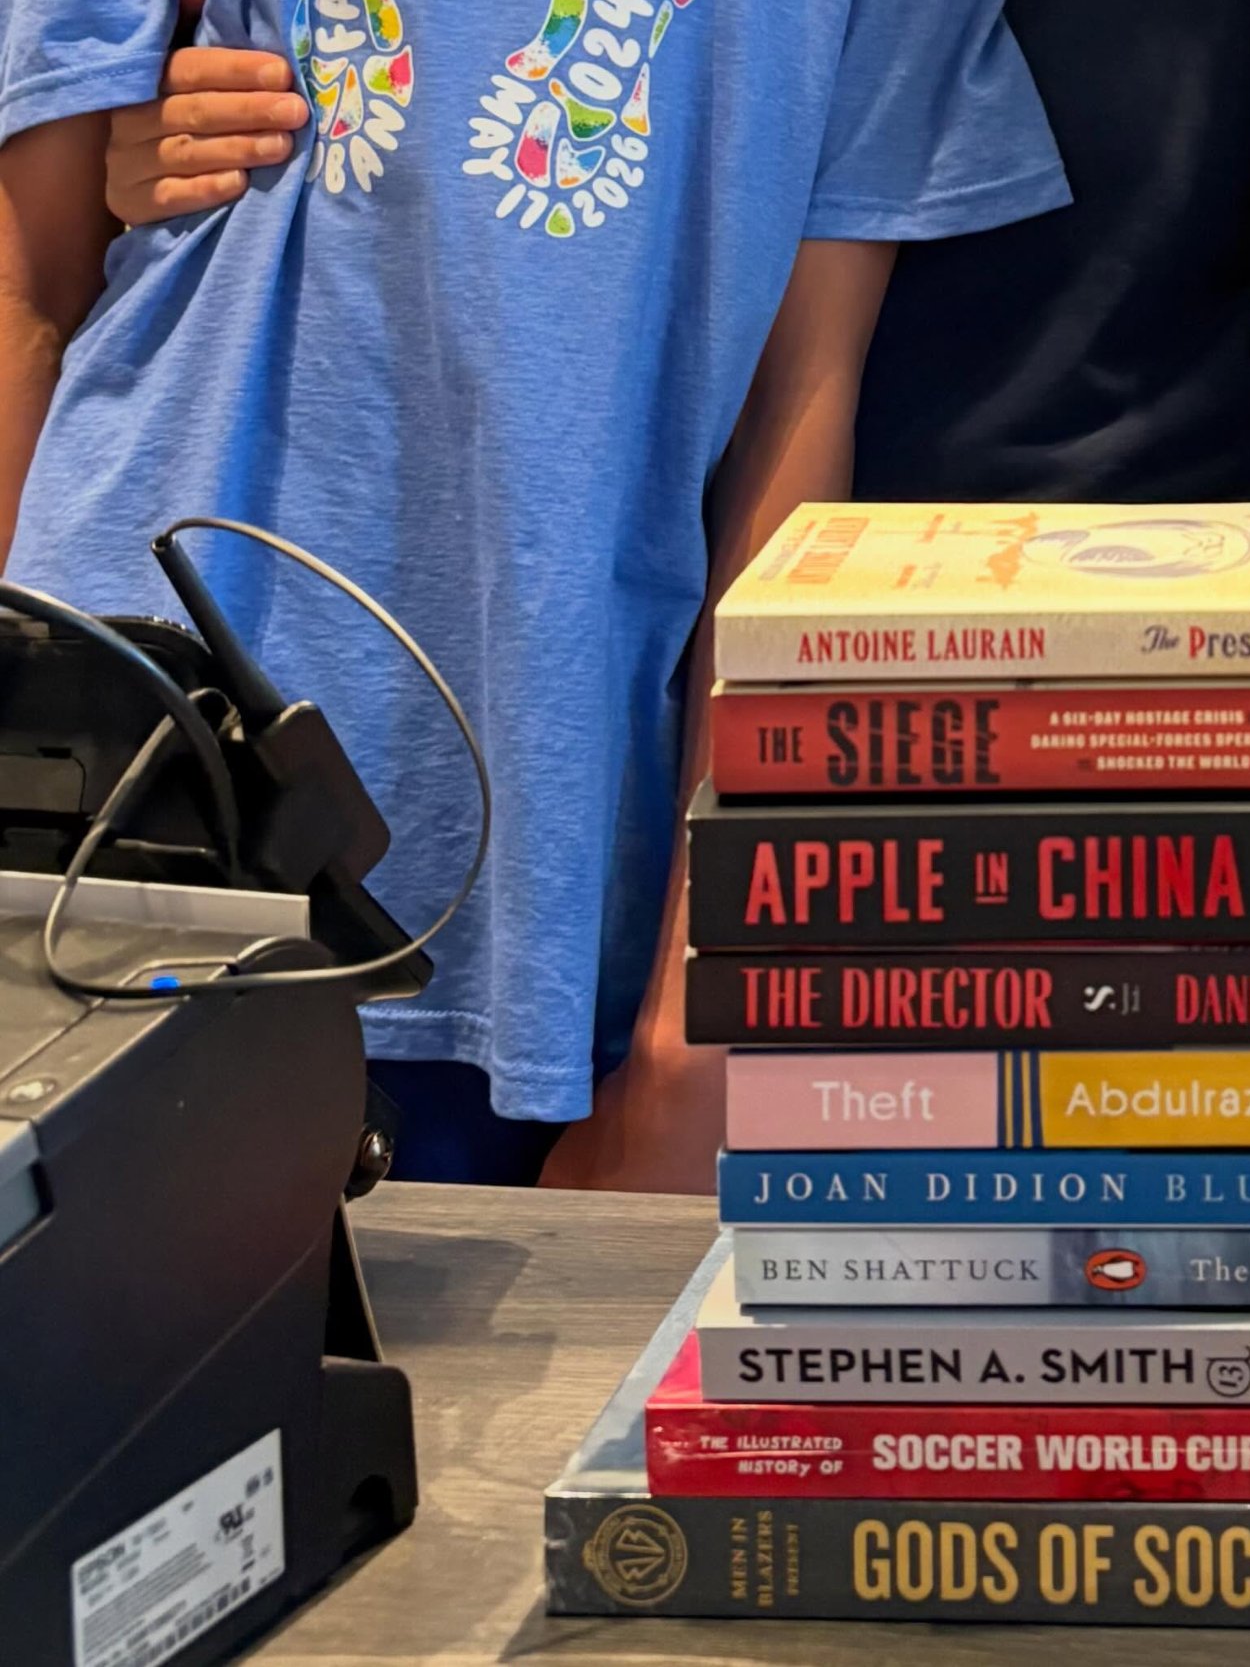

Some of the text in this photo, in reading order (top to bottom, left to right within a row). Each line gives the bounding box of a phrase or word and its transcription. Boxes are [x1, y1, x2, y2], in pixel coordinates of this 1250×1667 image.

[462, 75, 649, 229] MAY 17 2026
[798, 627, 1046, 664] ANTOINE LAURAIN
[1141, 625, 1180, 654] The
[1125, 711, 1190, 724] HOSTAGE
[1194, 710, 1245, 724] CRISIS
[757, 698, 1002, 787] THE SIEGE
[1031, 734, 1086, 748] DARING
[1097, 756, 1164, 770] SHOCKED
[1168, 756, 1195, 769] THE
[1199, 755, 1250, 769] WORLD
[744, 835, 1246, 925] APPLE IN CHINA
[741, 968, 823, 1028] THE
[842, 968, 1053, 1028] DIRECTOR
[811, 1080, 934, 1122] Theft
[755, 1173, 888, 1205] JOAN
[927, 1173, 1128, 1202] DIDION
[762, 1258, 1040, 1282] BEN SHATTUCK
[1190, 1257, 1249, 1282] The
[738, 1348, 1194, 1384] STEPHEN A. SMITH
[700, 1435, 843, 1450] THE ILLUSTRATED
[872, 1433, 1023, 1472] SOCCER
[1036, 1433, 1178, 1472] WORLD
[820, 1459, 843, 1474] OF
[730, 1517, 748, 1599] MEN IN
[756, 1511, 774, 1607] BLAZERS
[852, 1519, 1019, 1603] GODS
[1037, 1523, 1114, 1604] OF
